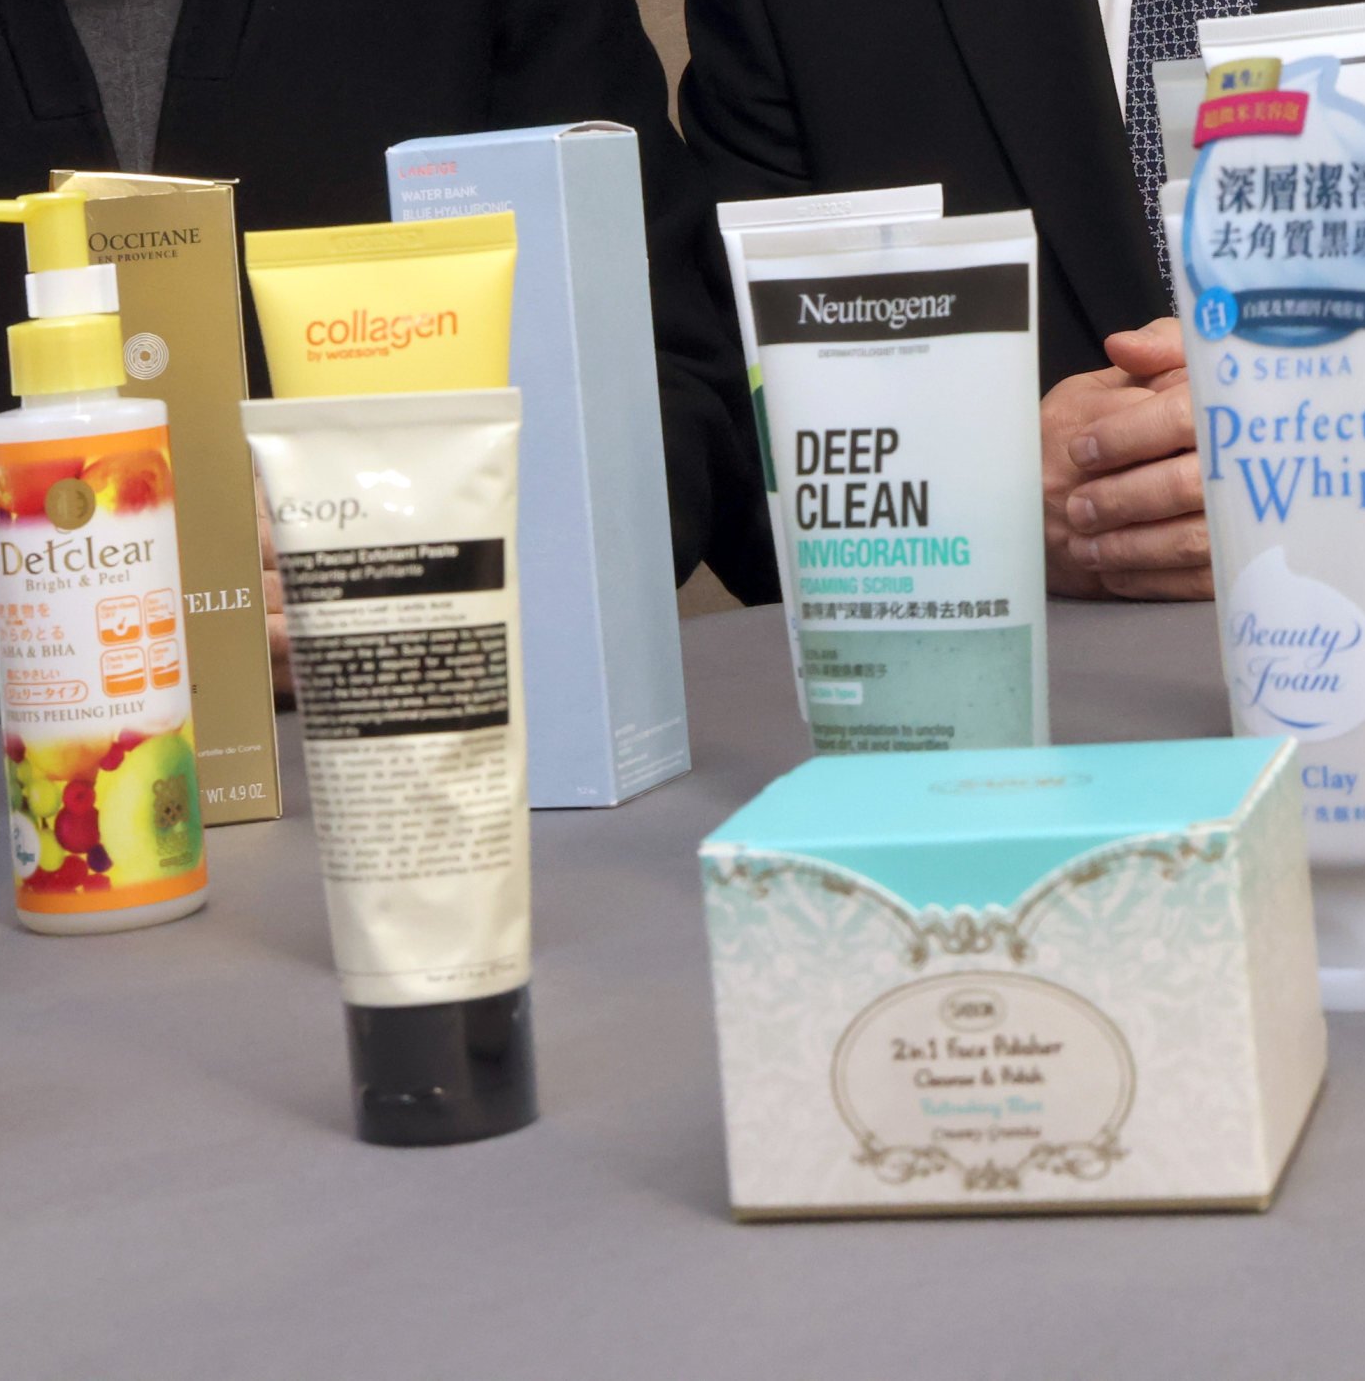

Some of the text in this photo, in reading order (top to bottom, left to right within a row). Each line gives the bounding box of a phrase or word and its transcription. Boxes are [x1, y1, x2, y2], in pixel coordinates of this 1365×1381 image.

[401, 185, 477, 203] WATER BANK
[89, 228, 202, 253] OCCITANE
[97, 249, 179, 265] EN PROVENCE
[797, 292, 956, 328] Neutrogena
[305, 309, 458, 350] collagen
[307, 347, 390, 363] by watsons
[1253, 354, 1352, 380] SENKA
[797, 428, 898, 477] DEEP
[797, 481, 929, 531] CLEAN
[0, 536, 155, 576] Detclear
[798, 536, 971, 569] INVIGORATING
[25, 570, 130, 593] Bright & Peel
[801, 575, 914, 596] FOAMING SCRUB
[42, 643, 75, 657] BHA
[1233, 610, 1363, 671] Beauty
[1236, 655, 1346, 707] Foam
[44, 700, 145, 722] PEELING JELLY
[1301, 766, 1357, 795] Clay
[206, 789, 226, 803] WT.
[229, 786, 246, 801] 4.9
